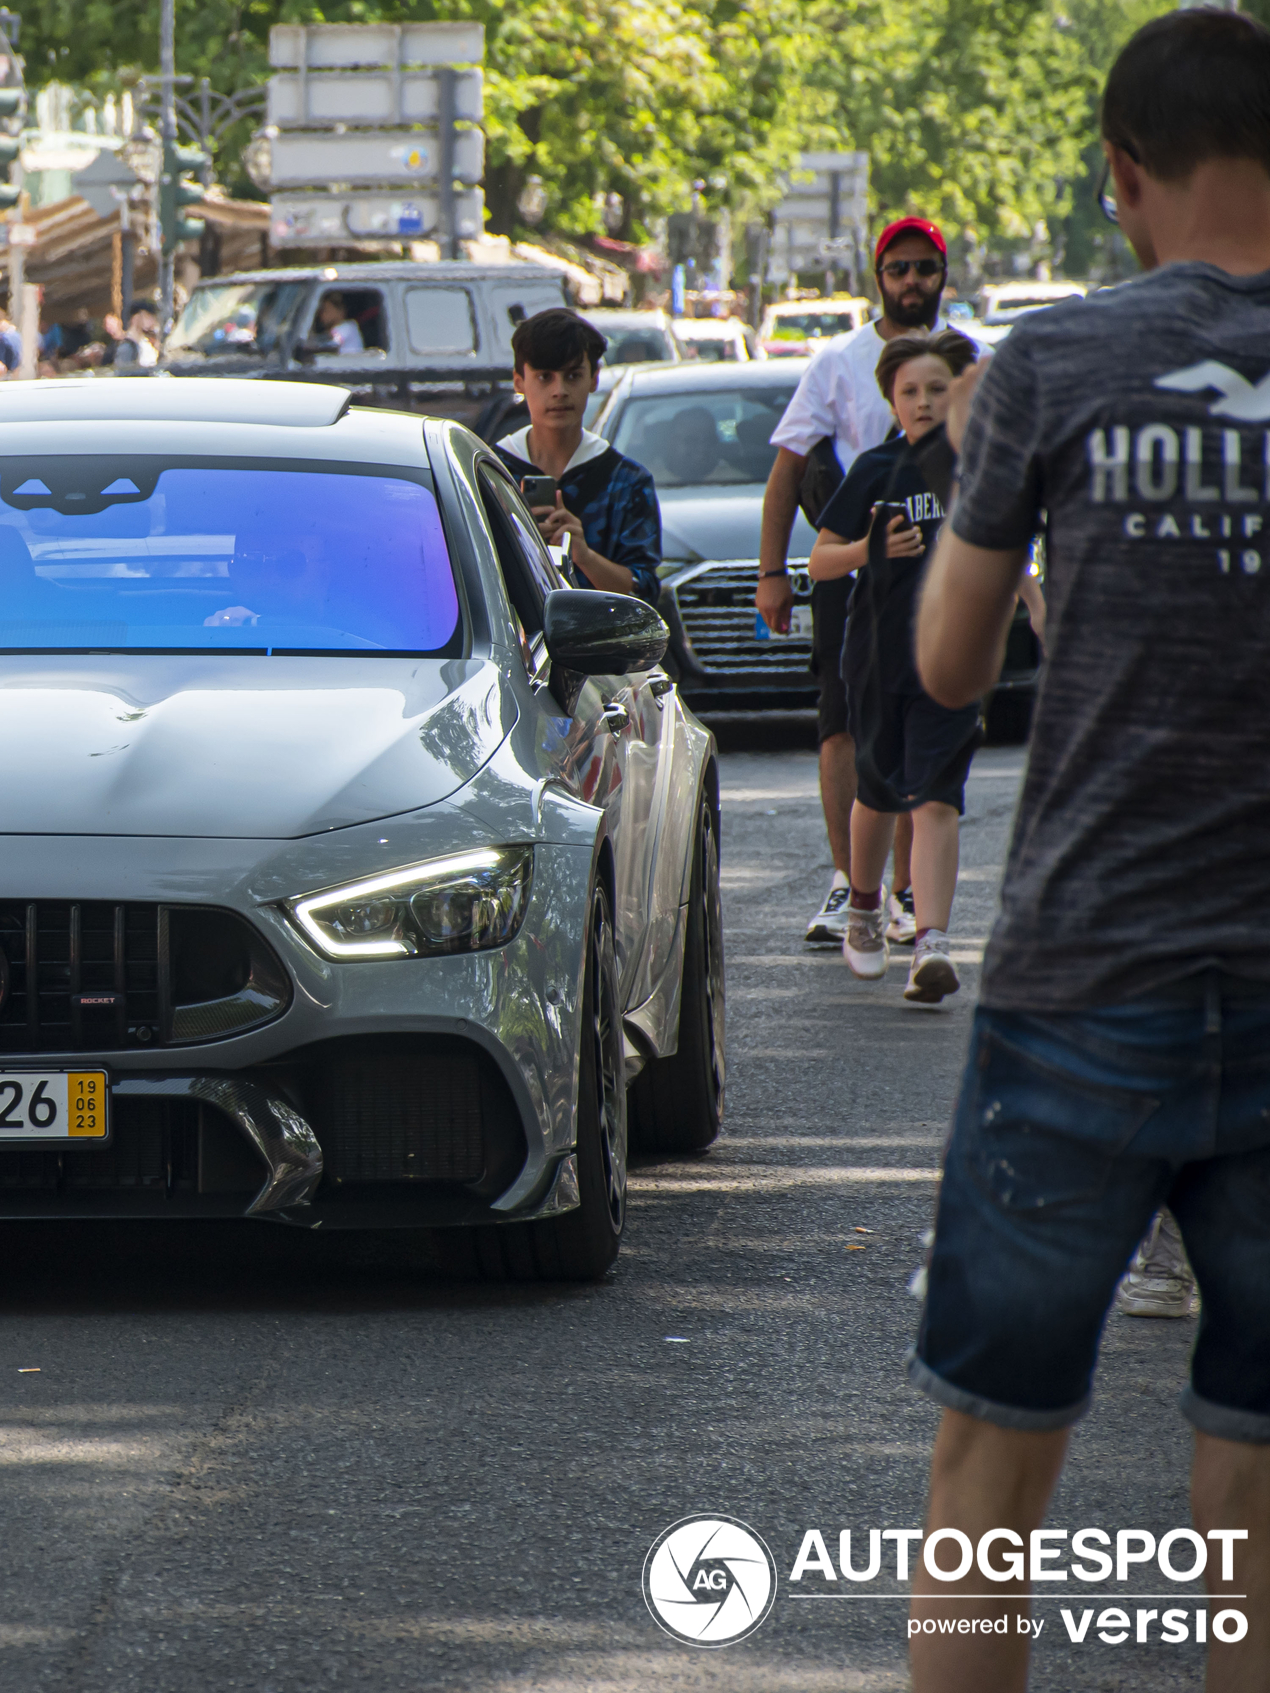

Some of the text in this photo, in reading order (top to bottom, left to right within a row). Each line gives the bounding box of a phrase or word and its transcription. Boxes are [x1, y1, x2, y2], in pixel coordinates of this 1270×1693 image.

[77, 1080, 96, 1094] 19
[76, 1097, 96, 1111] 06
[76, 1114, 96, 1128] 23
